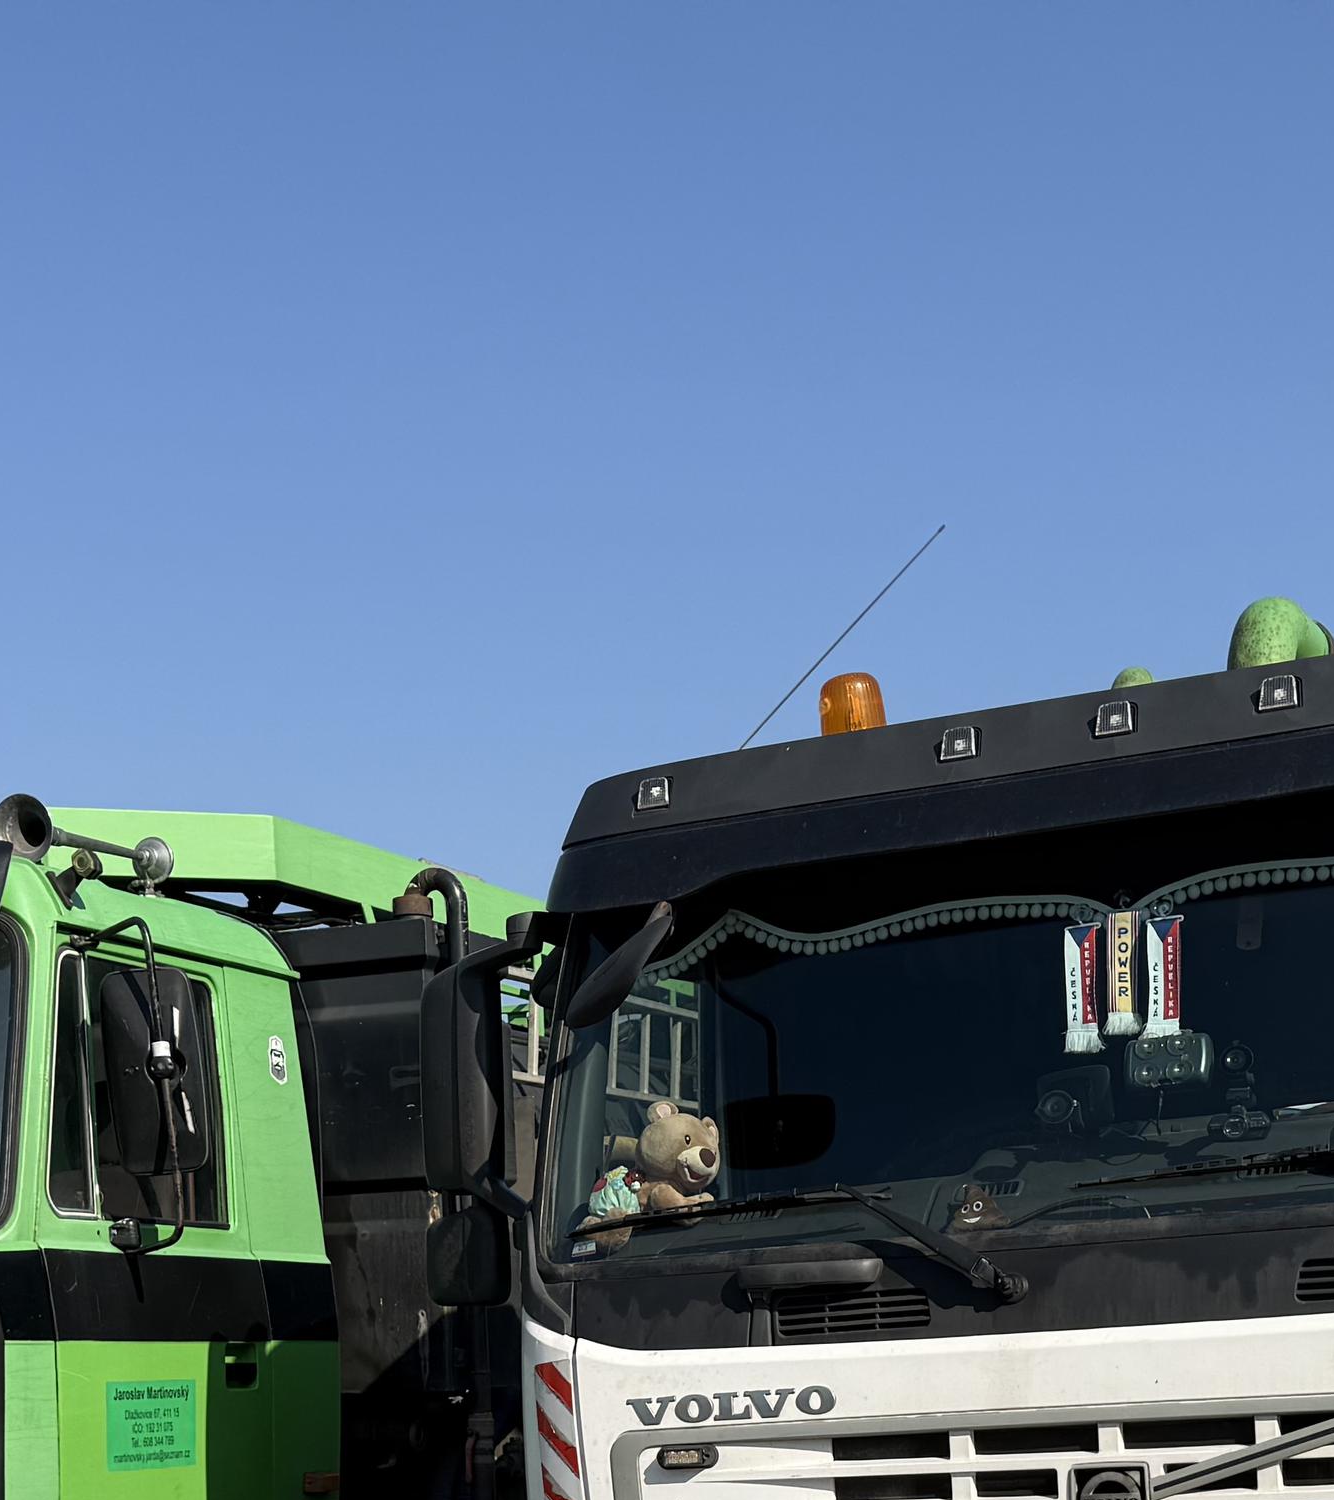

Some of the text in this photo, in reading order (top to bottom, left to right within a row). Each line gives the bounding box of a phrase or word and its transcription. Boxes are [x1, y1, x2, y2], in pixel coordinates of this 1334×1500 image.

[1117, 927, 1129, 997] POWER
[113, 1387, 145, 1401] Jaroslav
[626, 1385, 837, 1426] VOLVO
